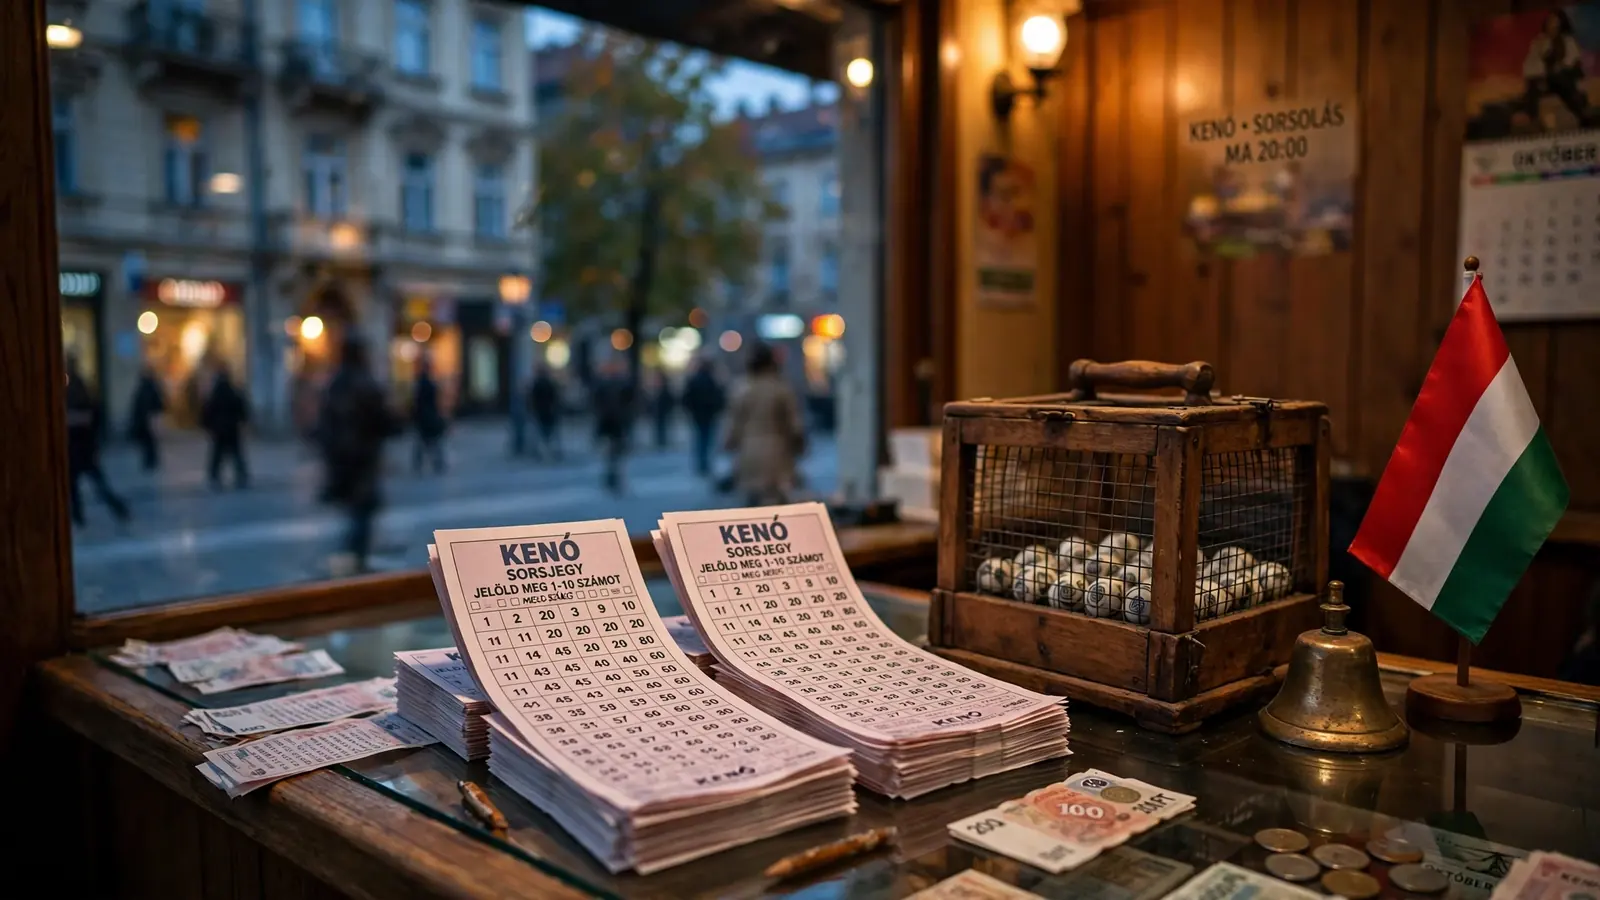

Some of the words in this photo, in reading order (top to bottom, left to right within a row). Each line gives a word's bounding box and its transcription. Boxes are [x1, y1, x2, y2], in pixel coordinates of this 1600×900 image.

[1189, 115, 1235, 141] KENÓ
[1253, 101, 1345, 134] SORSOLÁS
[1226, 142, 1252, 163] MA
[1257, 135, 1308, 162] 20:00
[719, 515, 788, 545] KENÓ
[499, 532, 580, 566] KENÓ
[726, 543, 791, 558] SORSJEGY
[740, 559, 762, 569] MEG
[764, 556, 785, 568] 1-10
[787, 552, 824, 565] SZÁMOT
[506, 563, 583, 581] SORSJEGY
[474, 583, 519, 598] JELÖLD
[522, 581, 548, 593] MEG
[551, 579, 575, 591] 1-10
[577, 574, 621, 588] SZÁMOT
[710, 589, 716, 598] 1
[734, 587, 742, 596] 2
[755, 584, 770, 593] 20
[782, 581, 791, 590] 3
[484, 617, 490, 626] 1
[513, 613, 522, 624] 2
[539, 610, 555, 620] 20
[570, 607, 579, 617] 3
[597, 604, 606, 613] 9
[622, 601, 636, 610] 10
[740, 603, 752, 612] 11
[763, 600, 778, 609] 20
[788, 597, 802, 606] 20
[811, 594, 825, 603] 20
[723, 622, 736, 630] 11
[796, 612, 811, 621] 20
[488, 636, 501, 646] 11
[518, 632, 532, 642] 11
[546, 628, 563, 638] 20
[575, 625, 591, 635] 20
[603, 622, 618, 632] 20
[629, 618, 644, 628] 20
[733, 637, 746, 645] 11
[495, 654, 509, 664] 11
[526, 650, 541, 660] 14
[555, 646, 572, 656] 45
[584, 643, 600, 652] 20
[612, 639, 628, 649] 20
[638, 635, 654, 645] 80
[504, 672, 519, 681] 11
[534, 667, 551, 676] 43
[565, 663, 581, 672] 45
[595, 659, 610, 667] 40
[623, 655, 638, 663] 40
[649, 651, 665, 660] 60
[513, 688, 528, 696] 11
[544, 683, 561, 691] 43
[575, 678, 592, 686] 45
[605, 673, 621, 681] 40
[632, 669, 650, 677] 50
[661, 665, 677, 673] 60
[688, 688, 704, 696] 60
[644, 710, 661, 718] 60
[1056, 803, 1104, 819] 100
